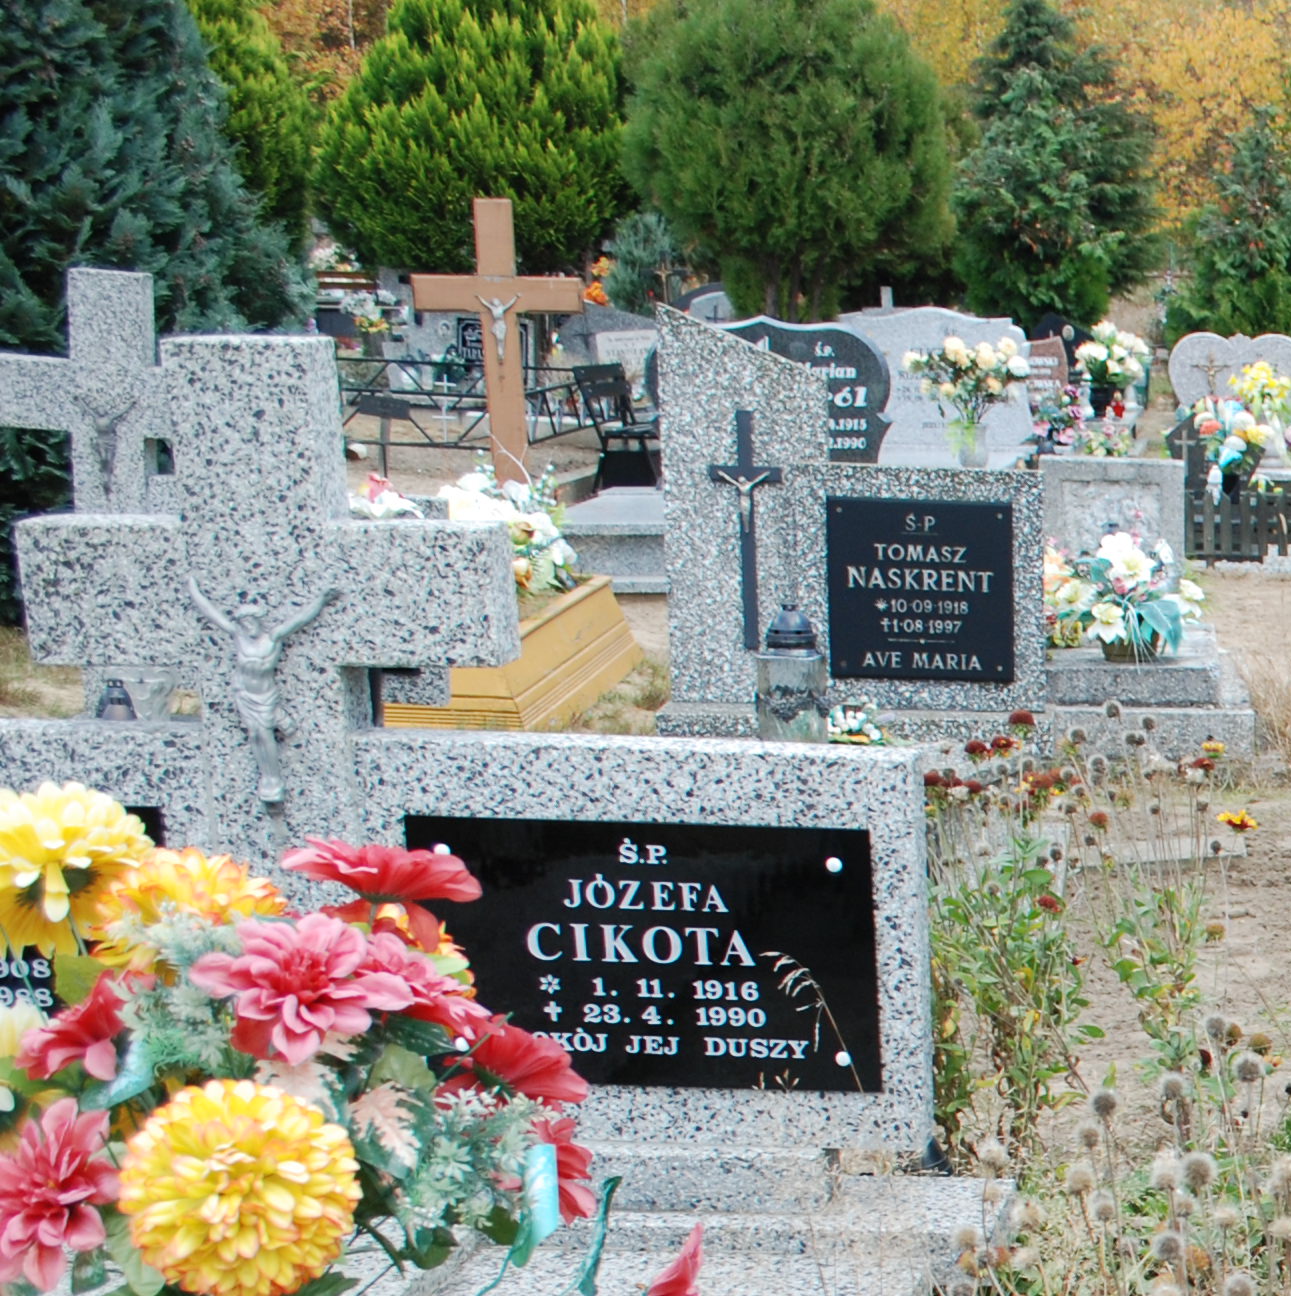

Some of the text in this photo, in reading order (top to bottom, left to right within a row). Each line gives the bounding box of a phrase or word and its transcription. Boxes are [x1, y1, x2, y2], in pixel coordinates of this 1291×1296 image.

[873, 543, 967, 563] TOMASZ
[846, 565, 994, 593] NASKRENT
[862, 651, 983, 671] AVE MARIA
[525, 922, 757, 967] CIKOTA
[591, 976, 760, 1001] 1. 11. 1916
[582, 1003, 767, 1028] 23. 4. 1990
[532, 1027, 809, 1060] KÓJ JEJ DUSZY
